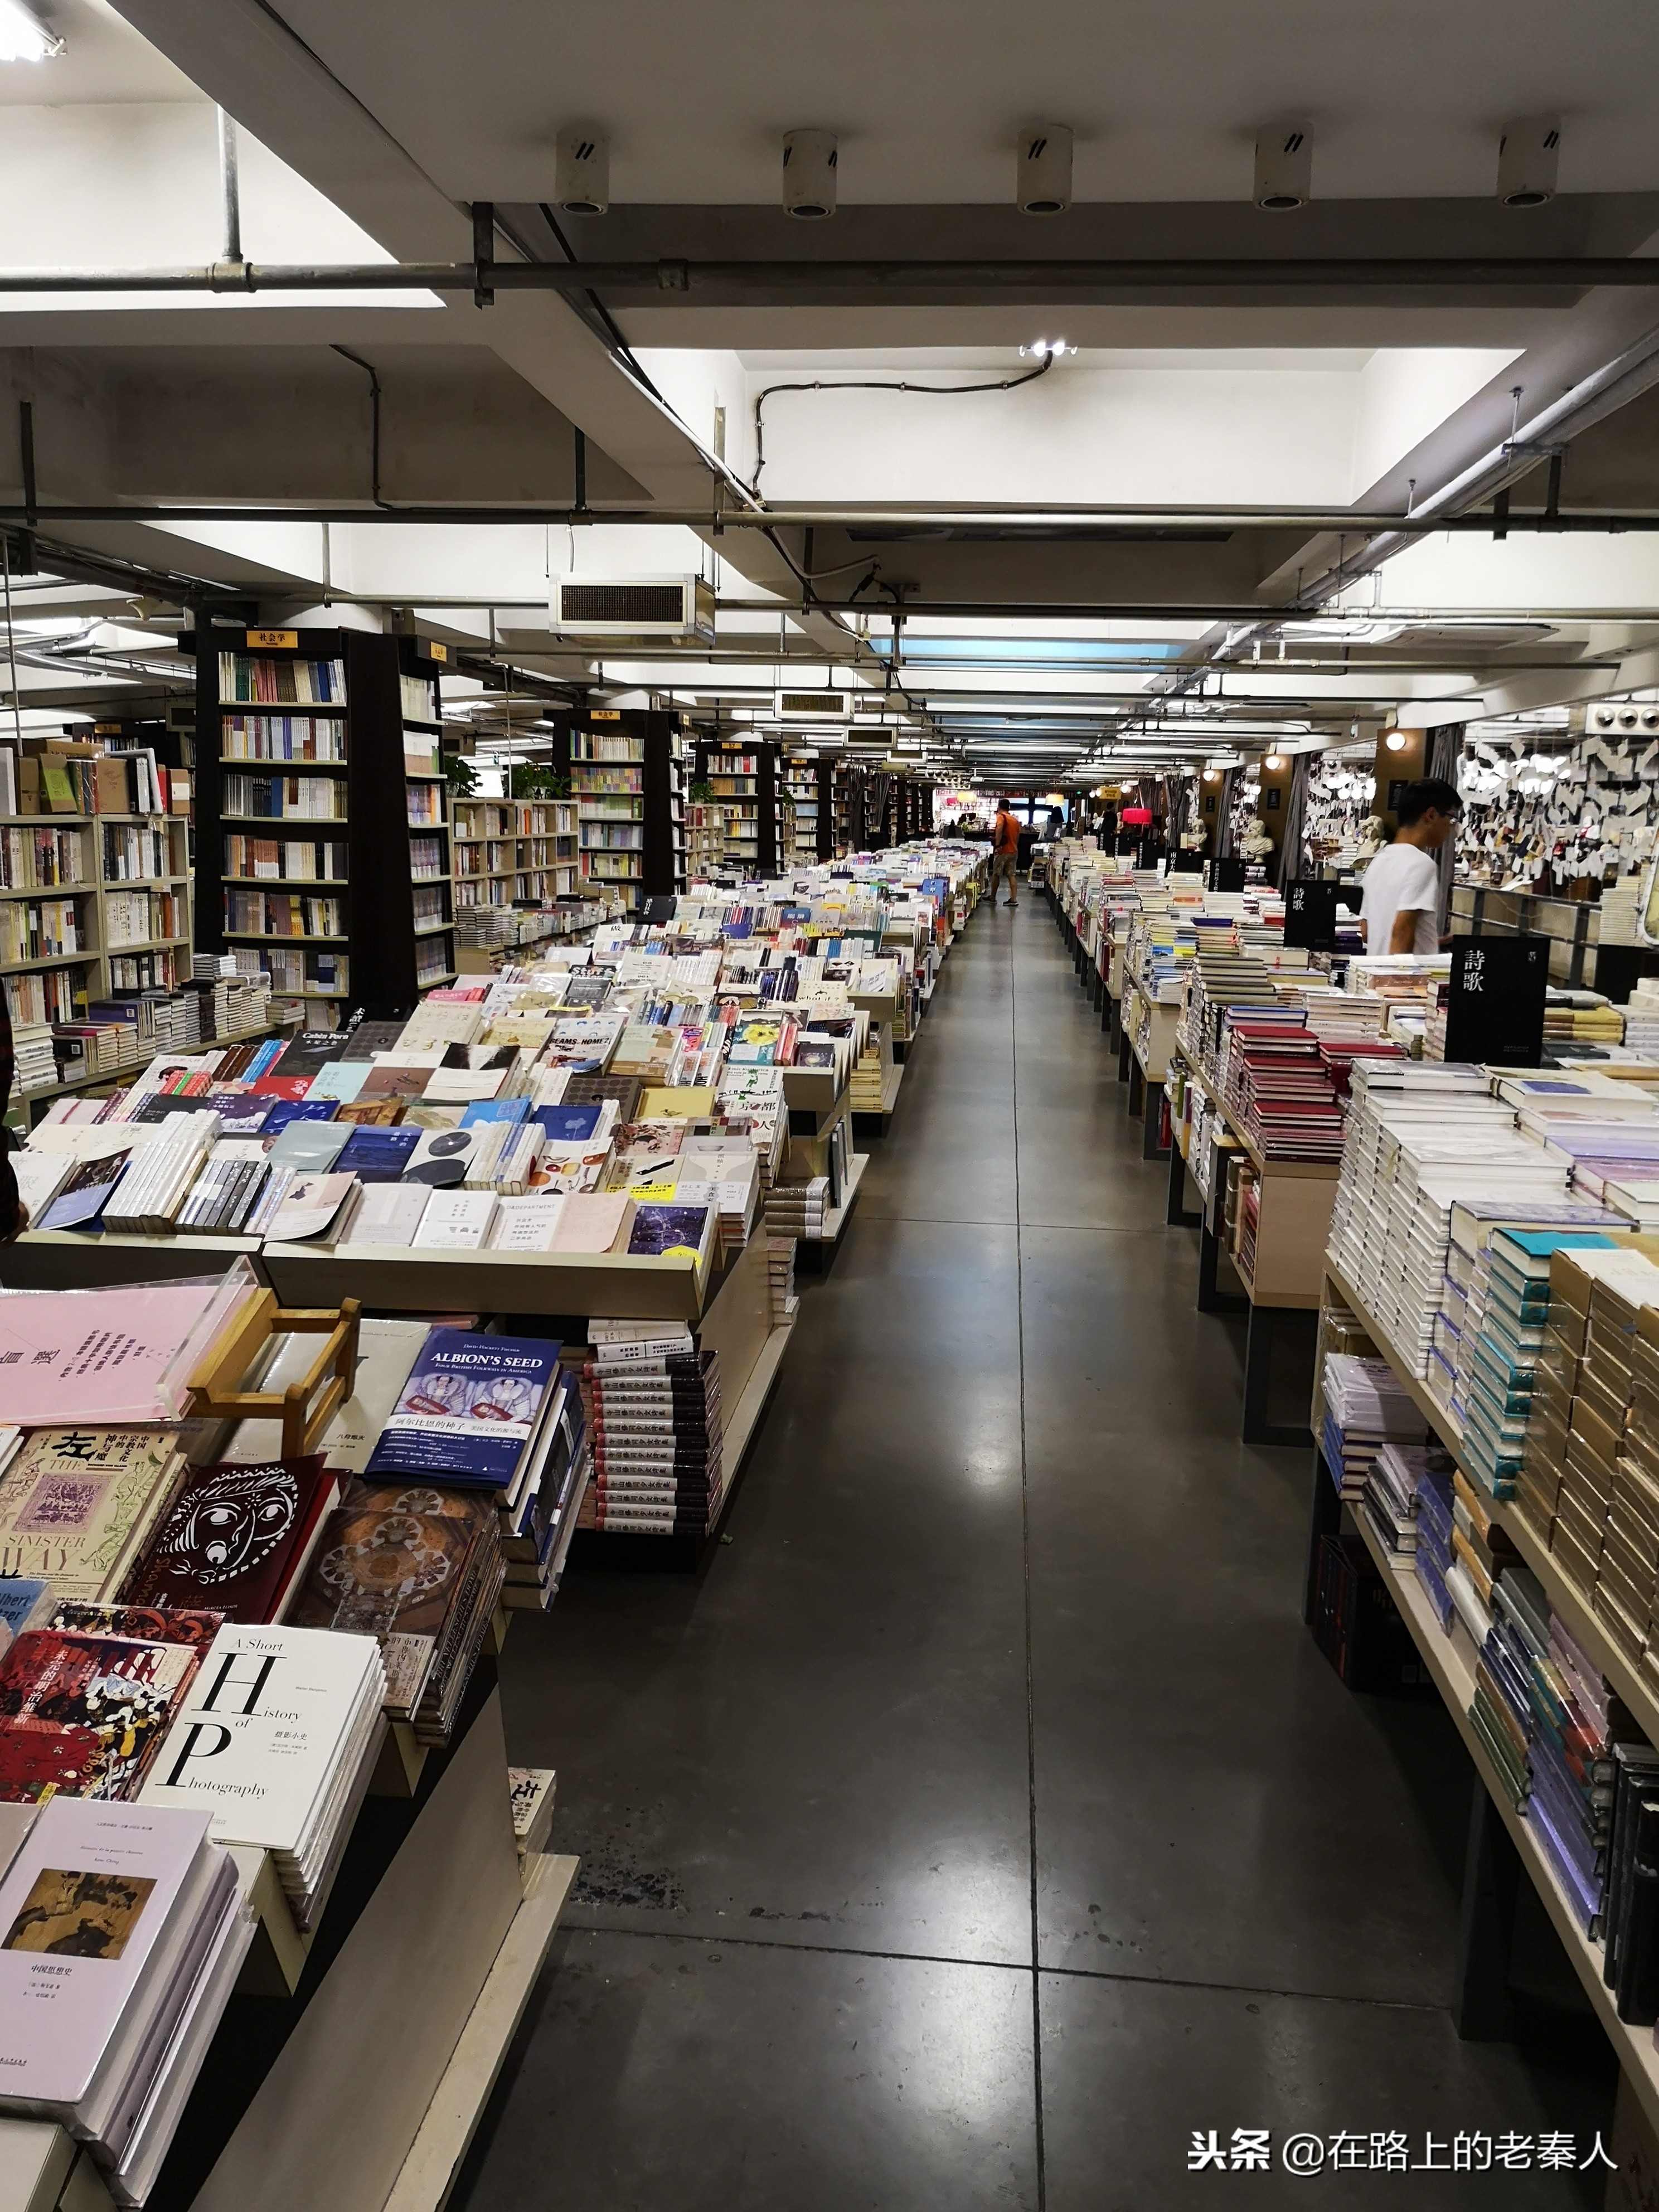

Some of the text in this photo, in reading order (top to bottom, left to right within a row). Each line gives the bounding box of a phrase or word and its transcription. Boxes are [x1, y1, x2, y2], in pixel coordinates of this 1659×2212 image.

[259, 632, 285, 642] 社会学
[1293, 887, 1305, 910] 詩歌
[1463, 950, 1486, 991] 詩歌
[759, 1120, 770, 1130] 人
[430, 1352, 543, 1368] ALBION'S SEED
[395, 1418, 465, 1430] 阿尔比恩的种子
[51, 1432, 96, 1461] 左
[95, 1434, 118, 1461] 神与魔
[115, 1434, 128, 1448] 中的
[119, 1434, 139, 1462] 宗教文化
[137, 1434, 150, 1449] 中国
[50, 1459, 85, 1471] THE
[5, 1535, 86, 1549] SINISTER
[2, 1546, 81, 1571] WAY
[0, 1593, 31, 1607] lbert
[0, 1611, 23, 1621] tzer
[231, 1638, 284, 1652] A Short
[18, 1650, 68, 1725] 未完的明治维新
[191, 1652, 302, 1724] History
[235, 1718, 253, 1728] of
[274, 1730, 307, 1741] 摄影小史
[155, 1722, 269, 1799] Photography
